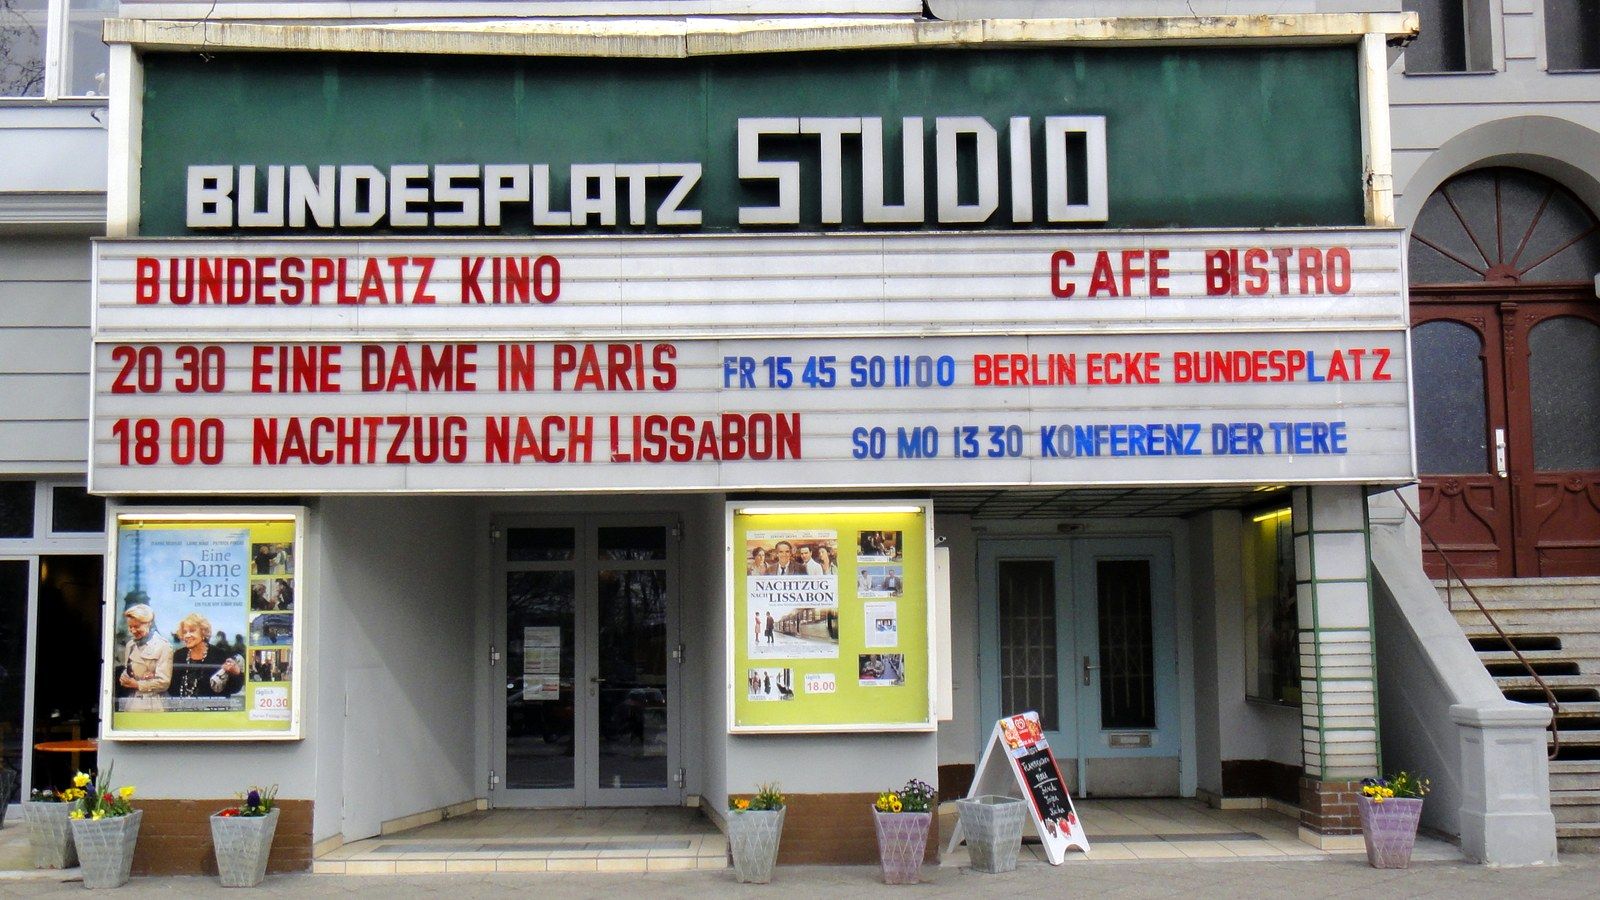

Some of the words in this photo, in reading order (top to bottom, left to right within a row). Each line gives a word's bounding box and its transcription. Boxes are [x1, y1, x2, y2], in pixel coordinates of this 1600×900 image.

[186, 163, 703, 229] BUNDESPLATZ
[737, 115, 1109, 224] STUDIO
[135, 256, 437, 305] BUNDESPLATZ
[461, 255, 561, 304] KINO
[1050, 249, 1169, 297] CAFE
[1205, 246, 1352, 295] BISTRO
[251, 345, 342, 393] EINE
[362, 344, 478, 392] DAME
[498, 344, 536, 392] IN
[553, 343, 677, 391] PARIS
[723, 355, 757, 390] FR
[972, 353, 1078, 387] BERLIN
[1086, 352, 1162, 386] ECKE
[1172, 347, 1392, 384] BUNDESPLATZ
[252, 416, 468, 465] NACHTZUG
[485, 416, 594, 464] NACH
[610, 411, 802, 463] LISSABON
[850, 427, 888, 461] SO
[897, 427, 940, 460] MO
[1040, 422, 1204, 459] KONFERENZ
[1211, 422, 1265, 457] DER
[1269, 421, 1349, 456] TIERE
[179, 559, 241, 578] Dame
[201, 548, 232, 561] Eine
[173, 580, 186, 592] in
[189, 578, 240, 598] Paris
[755, 580, 829, 591] NACHTZUG
[769, 592, 834, 603] LISSABON
[807, 681, 835, 691] 18.00
[260, 698, 288, 708] 20.30
